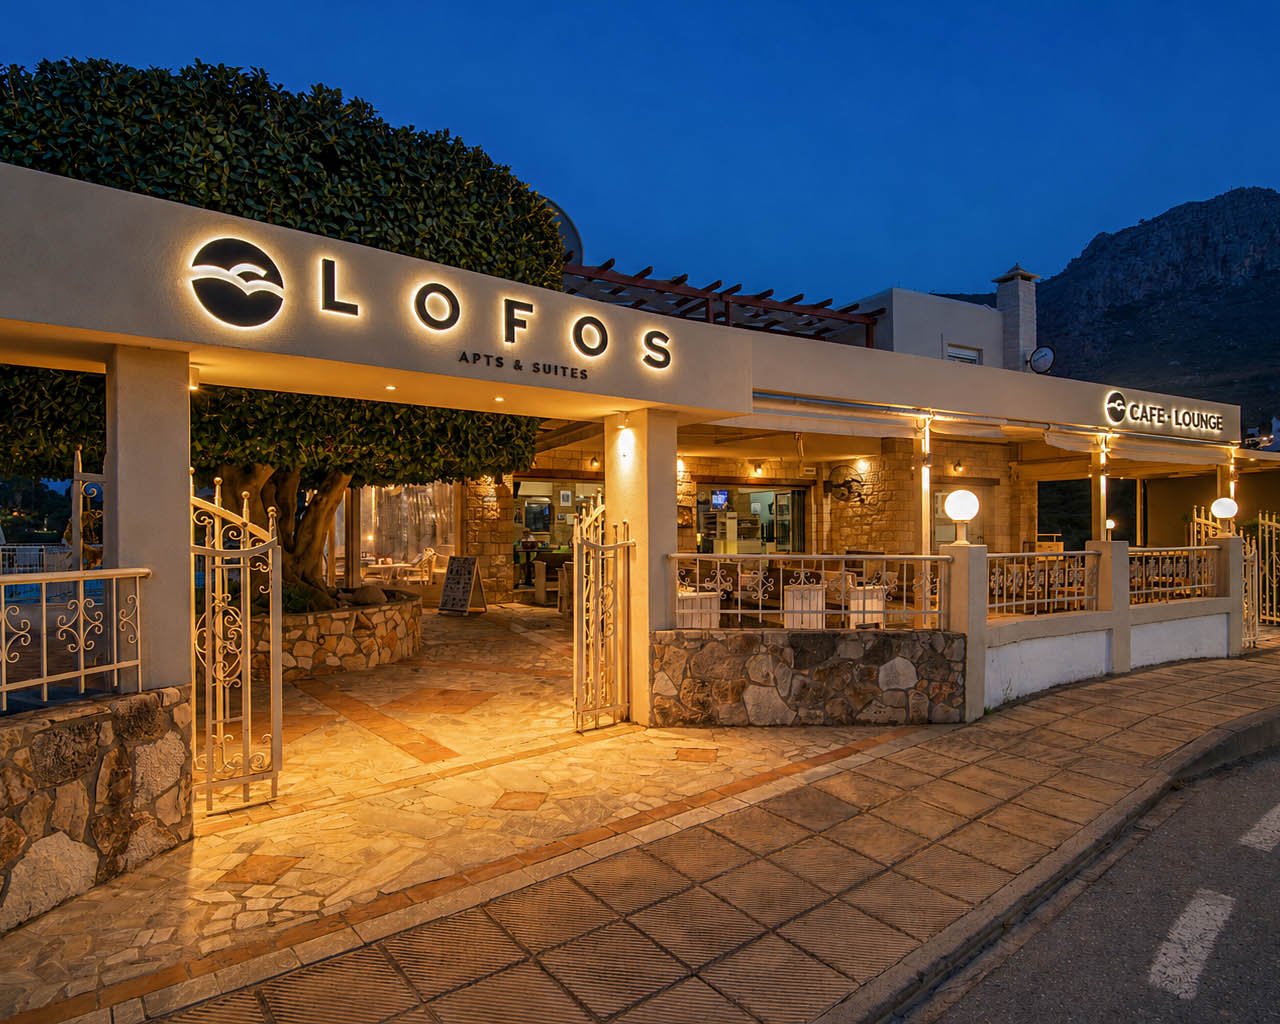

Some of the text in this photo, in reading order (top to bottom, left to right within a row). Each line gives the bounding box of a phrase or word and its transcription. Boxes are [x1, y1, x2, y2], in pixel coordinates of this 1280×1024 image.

[322, 259, 671, 369] LOFOS
[459, 352, 588, 380] APTS & SUITES
[1174, 409, 1223, 430] LOUNGE
